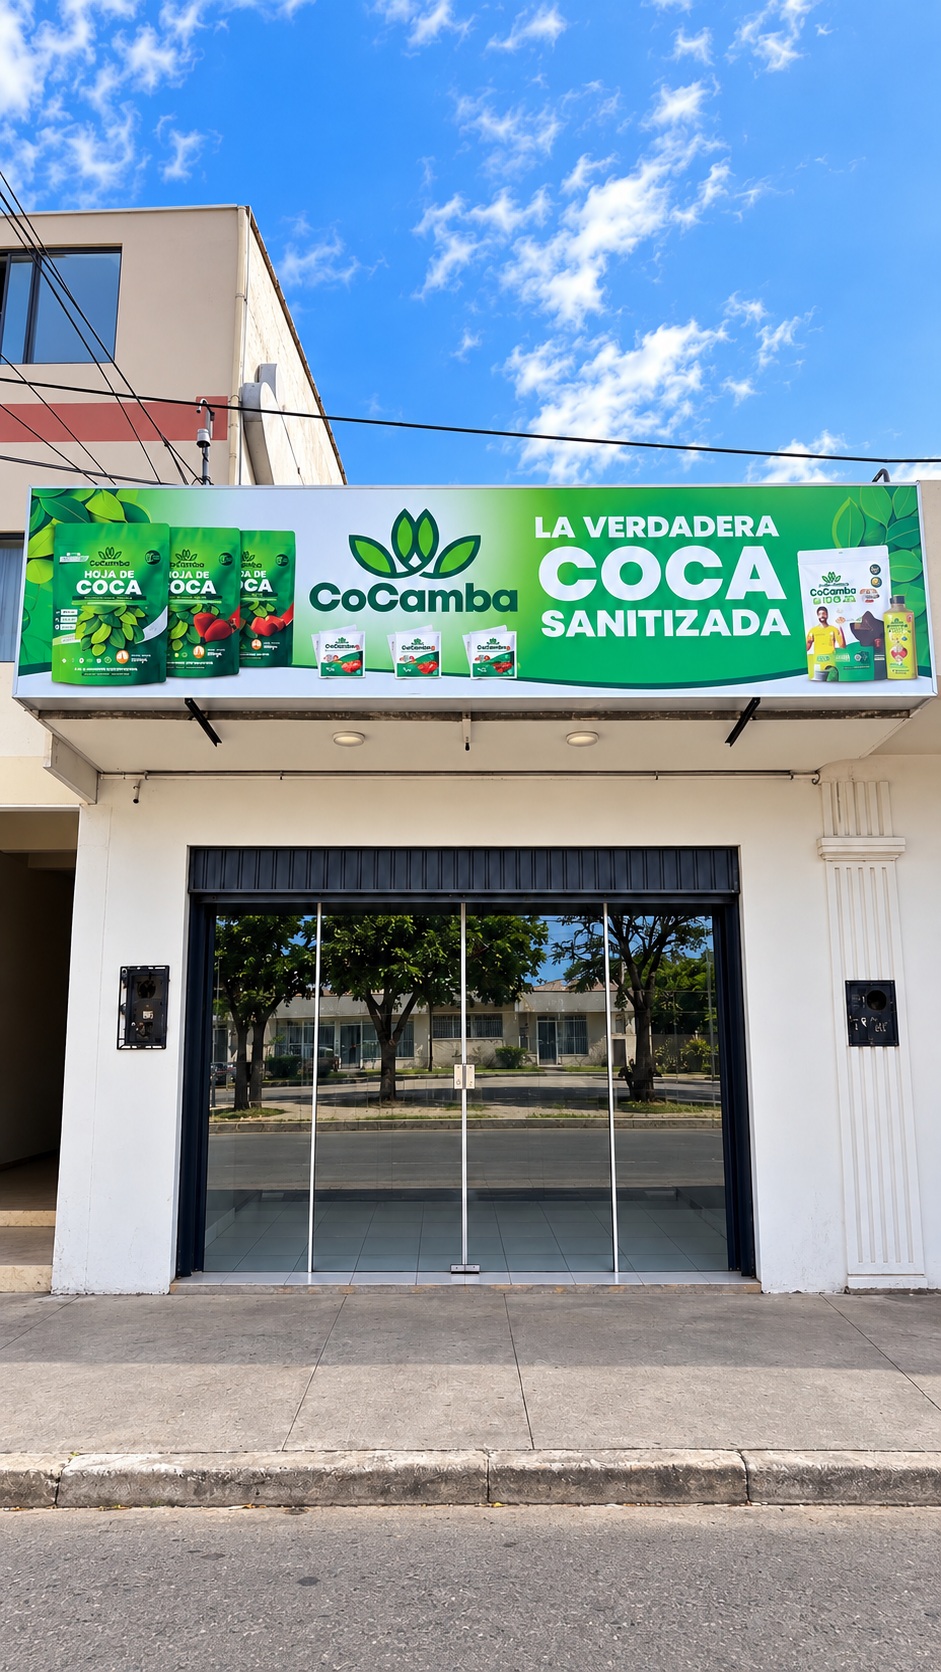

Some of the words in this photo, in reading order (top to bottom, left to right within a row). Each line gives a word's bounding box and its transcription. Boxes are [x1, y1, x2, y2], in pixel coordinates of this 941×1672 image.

[534, 516, 576, 538] LA
[582, 515, 780, 538] VERDADERA
[84, 570, 117, 579] HOJA
[119, 570, 135, 579] DE
[195, 570, 210, 579] DE
[253, 570, 267, 578] DE
[538, 545, 788, 602] COCA
[76, 579, 143, 595] COCA
[168, 579, 217, 595] OCA
[810, 586, 857, 597] CoCamba
[309, 582, 518, 612] CoCamba
[541, 609, 791, 638] SANITIZADA
